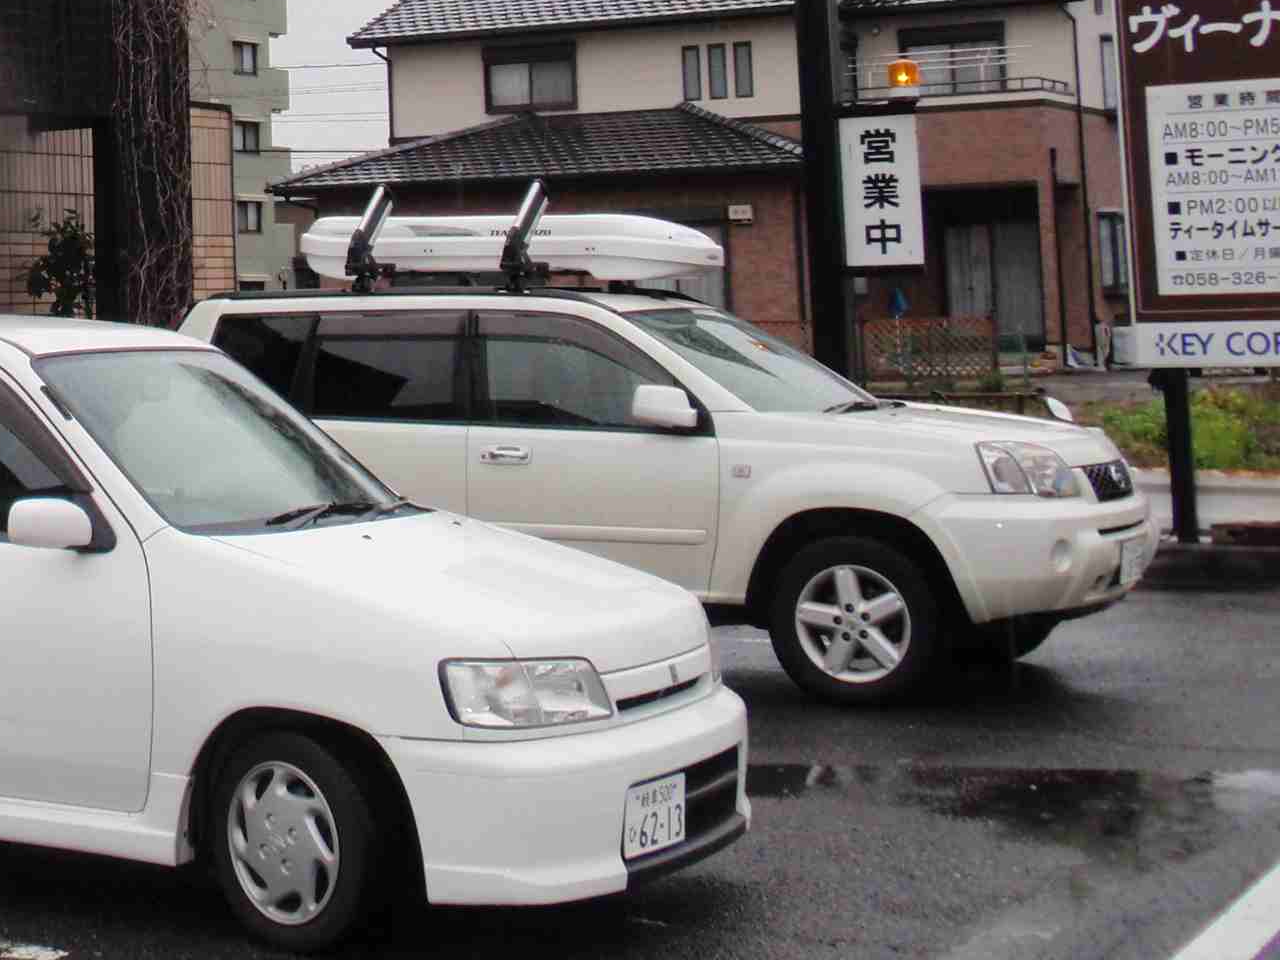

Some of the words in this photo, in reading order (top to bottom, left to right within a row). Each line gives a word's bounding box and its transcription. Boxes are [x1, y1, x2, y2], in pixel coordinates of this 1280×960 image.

[860, 128, 902, 255] 営業中
[1155, 331, 1215, 356] KEY
